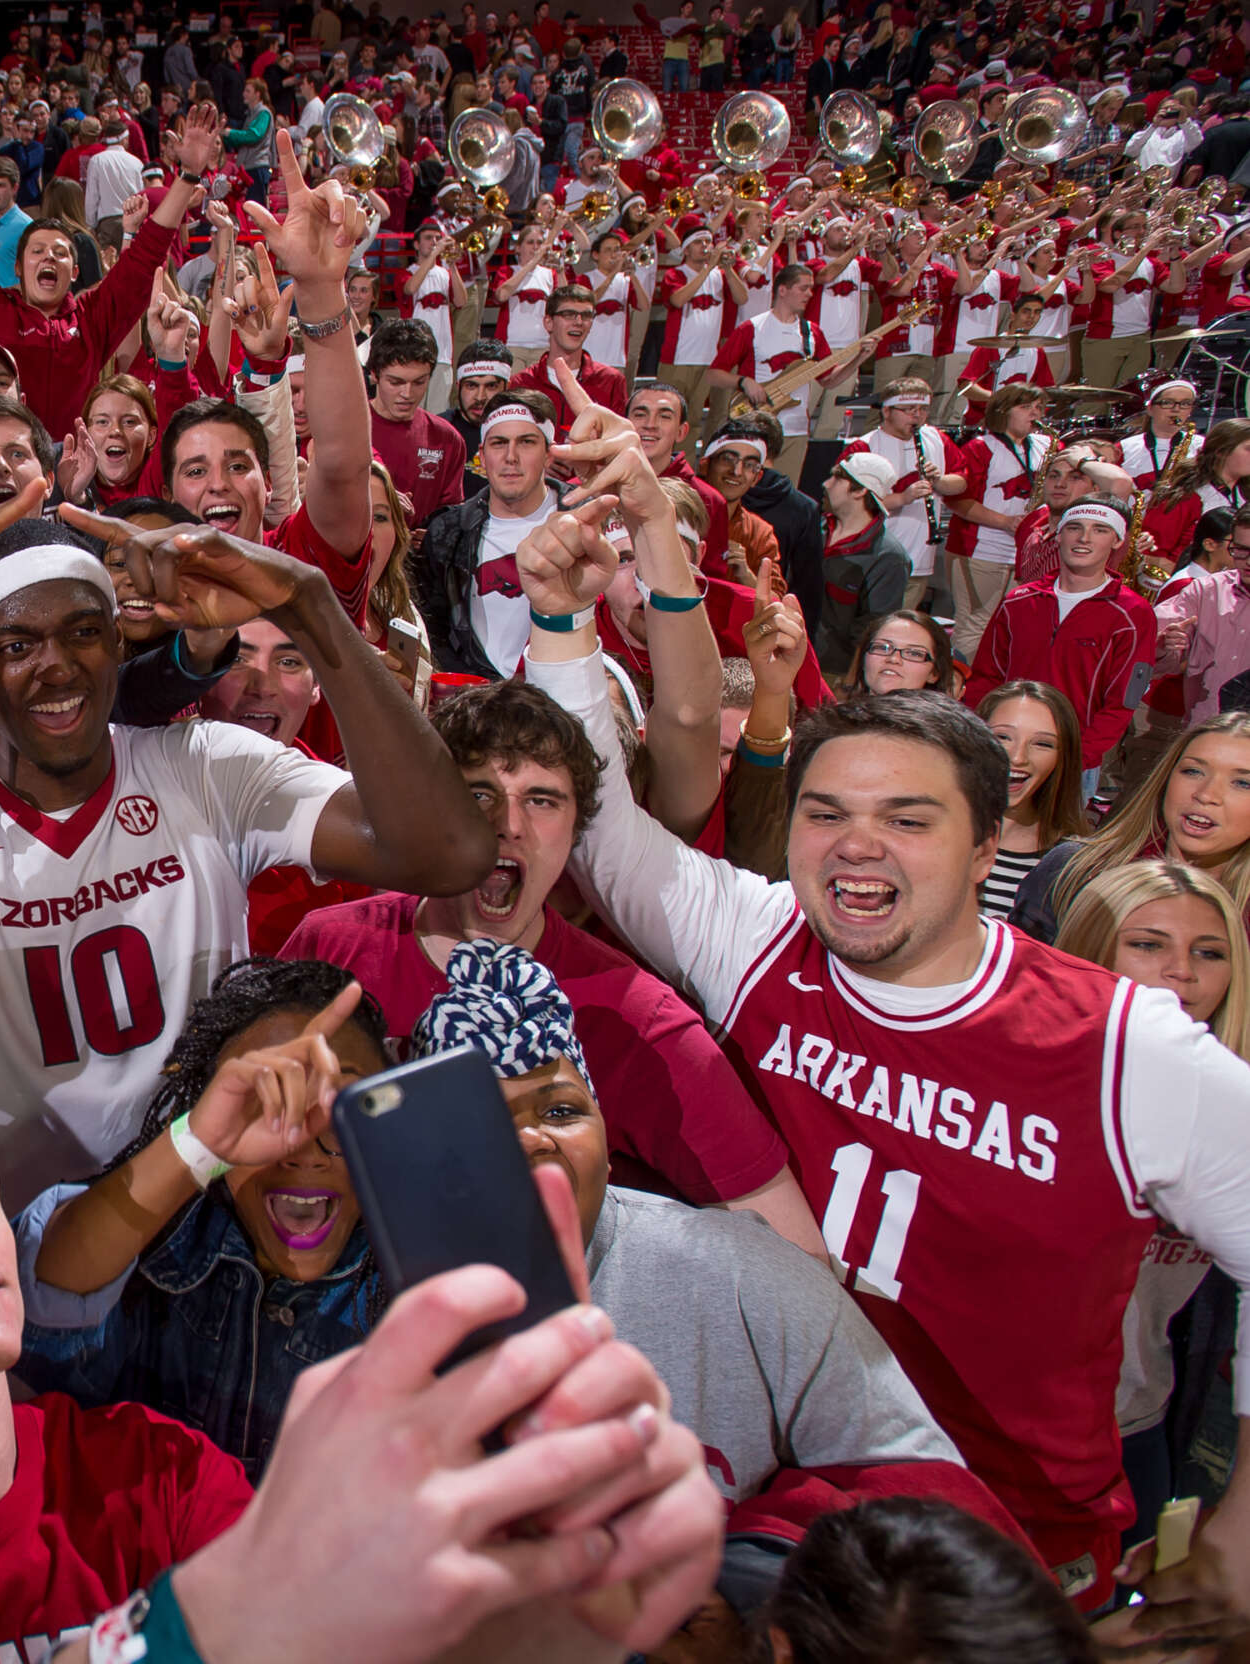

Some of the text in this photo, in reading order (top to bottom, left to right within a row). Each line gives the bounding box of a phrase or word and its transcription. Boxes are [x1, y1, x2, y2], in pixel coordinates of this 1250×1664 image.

[117, 797, 156, 833] SEC
[23, 924, 166, 1068] 10
[757, 1022, 1060, 1184] ARKANSAS
[821, 1141, 923, 1304] 11
